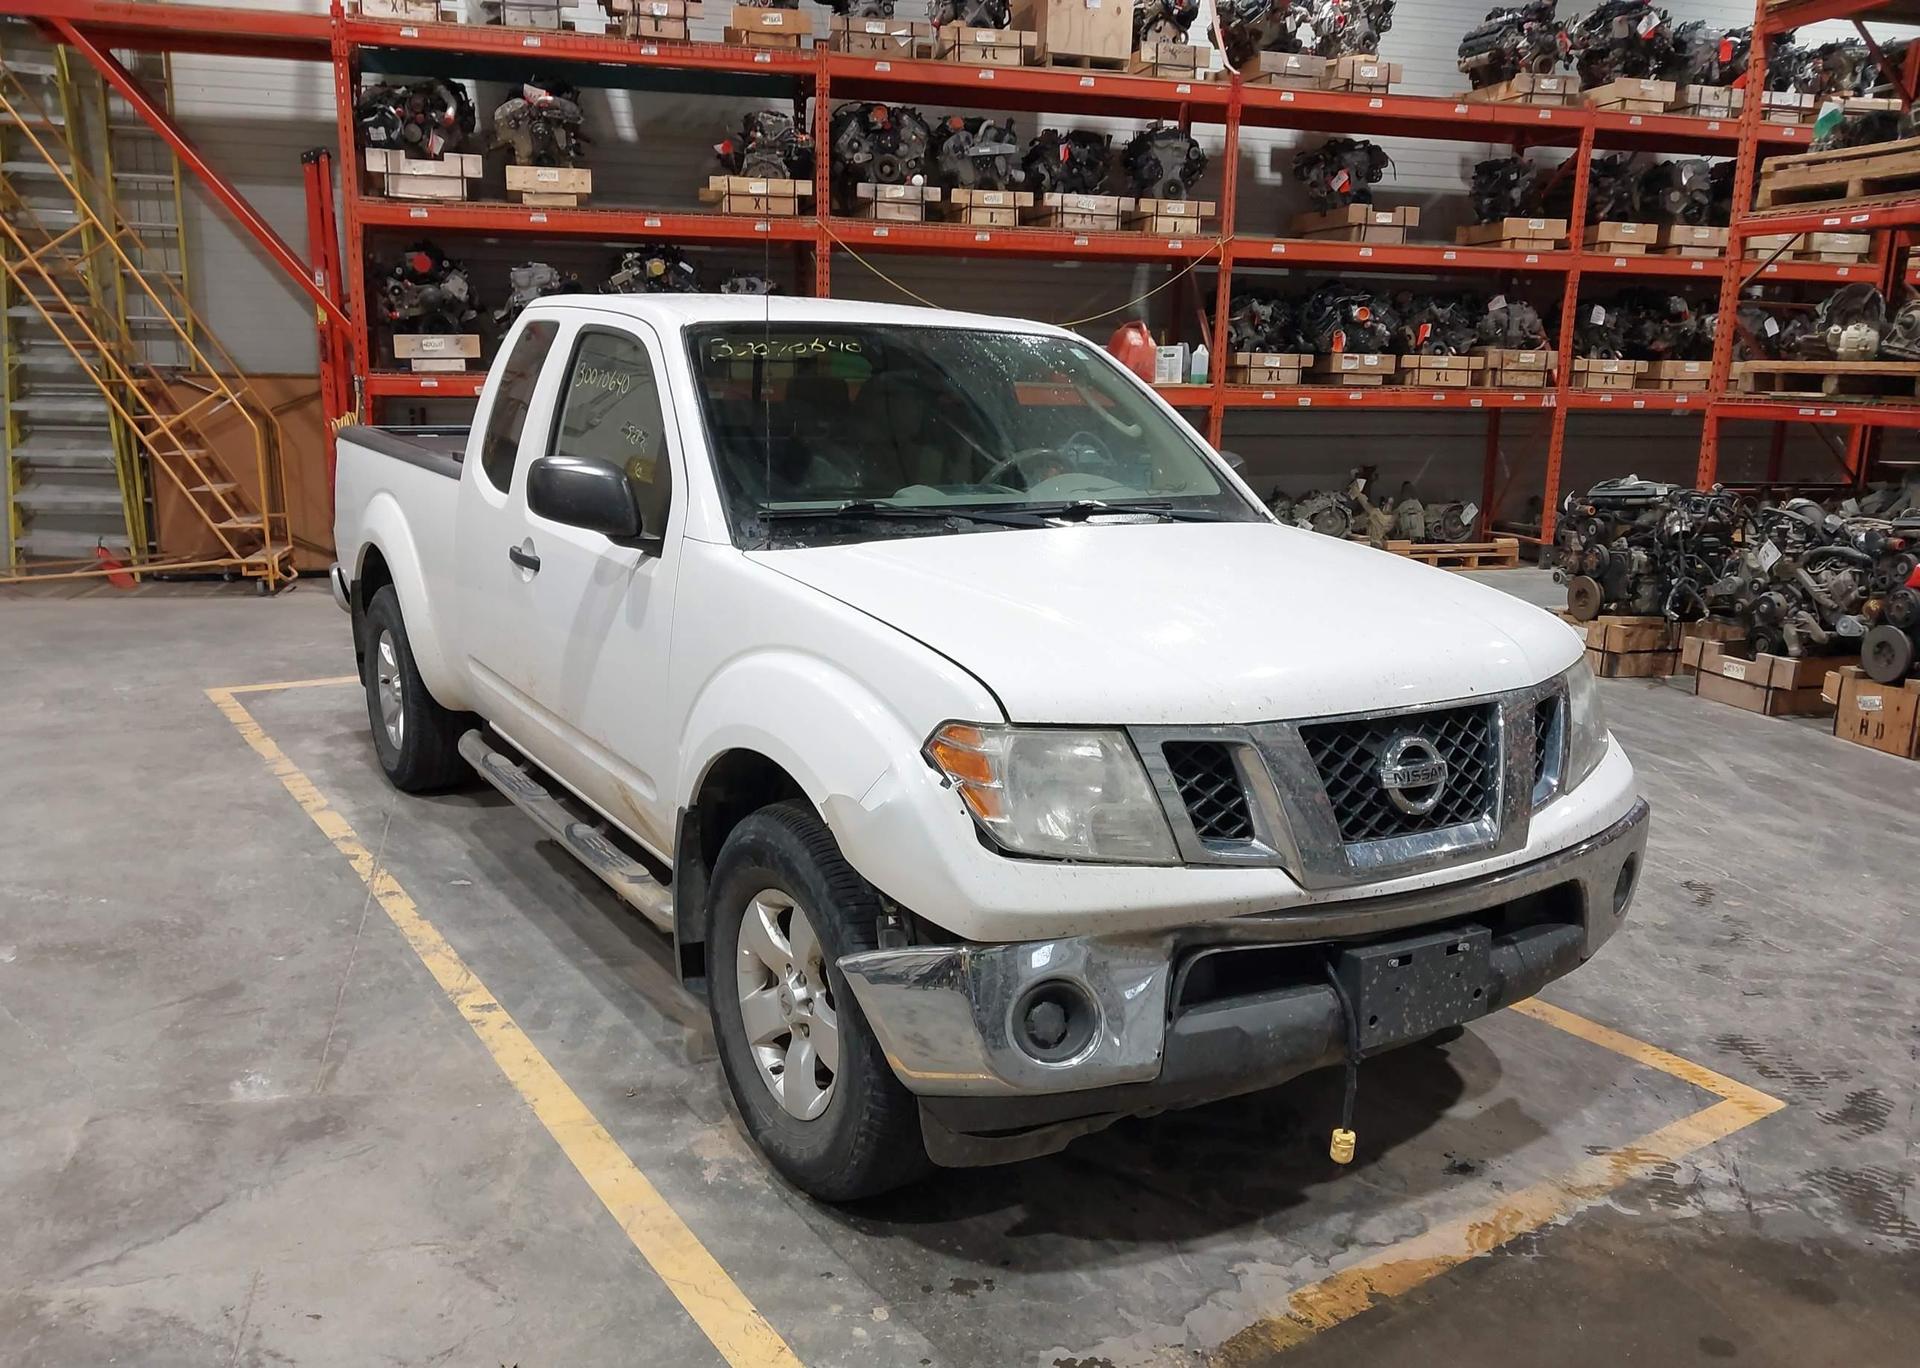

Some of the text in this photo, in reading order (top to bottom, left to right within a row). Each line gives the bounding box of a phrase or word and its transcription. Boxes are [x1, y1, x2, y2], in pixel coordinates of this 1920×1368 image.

[870, 38, 887, 49] XL
[981, 48, 998, 60] XL
[1267, 370, 1281, 381] XL
[1435, 371, 1449, 382] XL
[1541, 395, 1557, 407] AA
[1393, 764, 1445, 784] NISSAN
